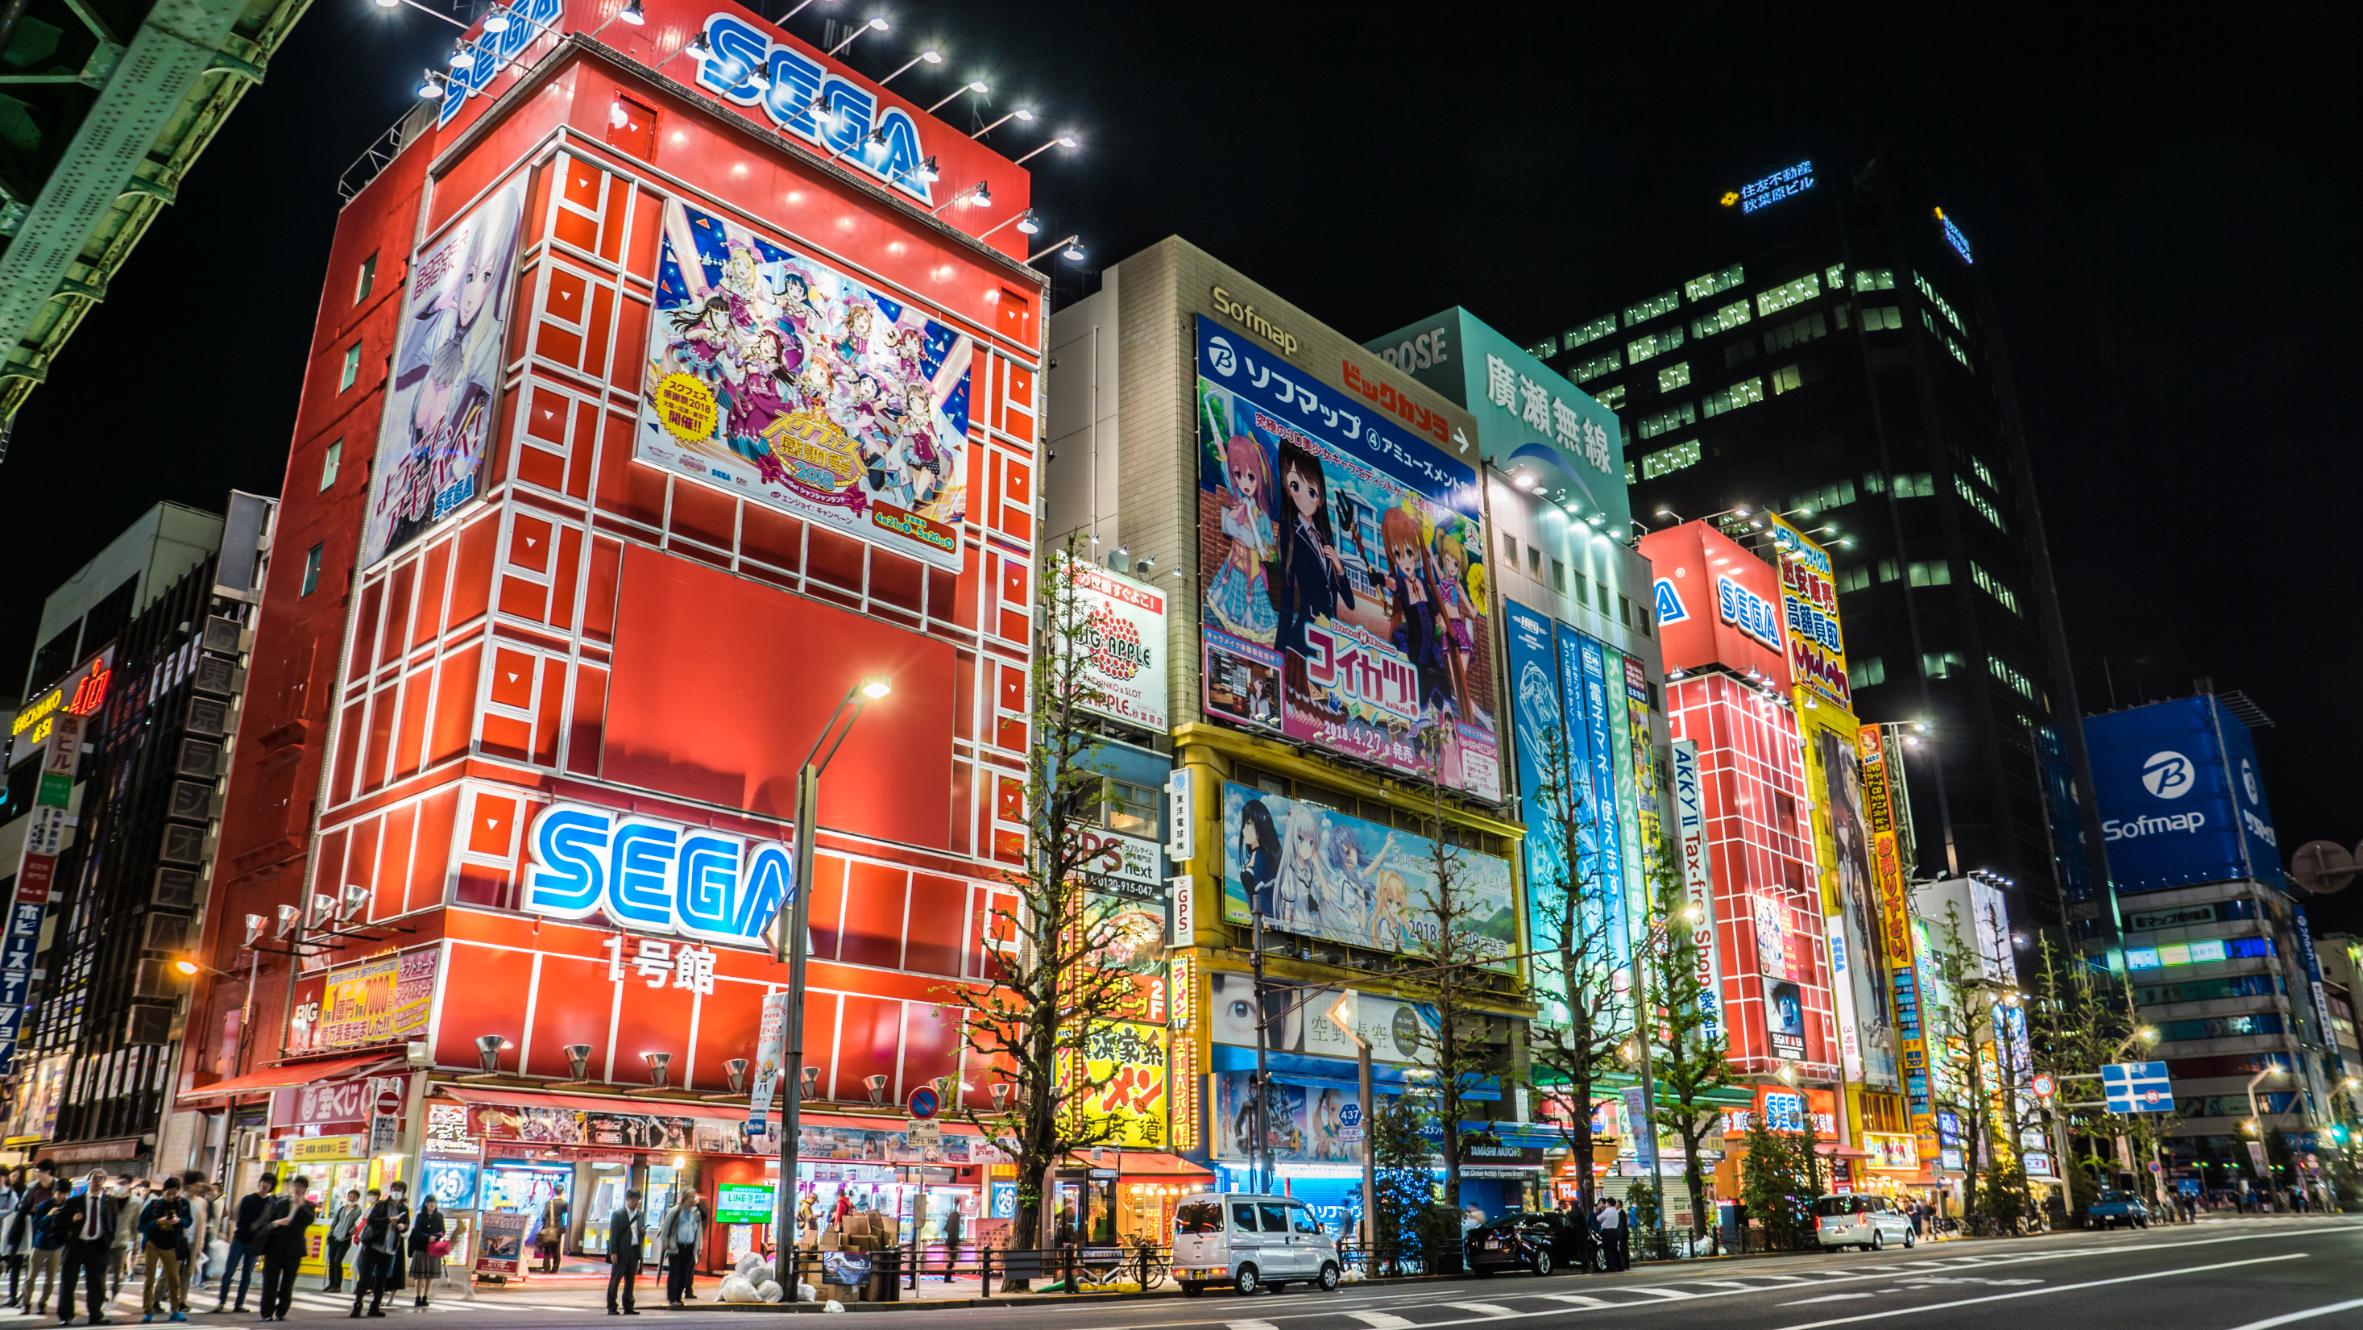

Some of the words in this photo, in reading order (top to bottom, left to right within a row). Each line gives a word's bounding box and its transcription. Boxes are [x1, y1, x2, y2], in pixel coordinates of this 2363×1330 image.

[695, 11, 934, 207] SEGA
[1741, 160, 1812, 199] 住友不動産
[1742, 176, 1814, 214] 秋葉原ビル
[1213, 287, 1298, 355] Sofmap
[663, 389, 711, 414] 感謝祭2018
[669, 381, 708, 401] スクフェス
[1245, 357, 1361, 439] ソフマップ
[1343, 359, 1449, 443] ビックカメラ
[668, 411, 702, 433] 開催!!
[1486, 353, 1612, 474] 廣瀬無線
[779, 431, 852, 478] 感謝祭
[795, 460, 835, 491] 2018
[432, 471, 475, 522] SEGA
[1718, 575, 1783, 655] SEGA
[1786, 596, 1841, 654] 高額買取
[1109, 636, 1152, 669] APPLE
[1124, 687, 1142, 698] SLOT
[2102, 811, 2205, 842] Sofmap
[523, 802, 802, 948] SEGA
[1125, 864, 1153, 879] next
[1675, 747, 1697, 811] AKKY
[1695, 931, 1712, 990] Shop
[1178, 889, 1188, 931] GPS
[603, 936, 717, 995] 1号館
[1831, 936, 1846, 973] SEGA
[1150, 980, 1164, 1020] 2F
[1173, 967, 1187, 1016] ラーメン
[1174, 1019, 1187, 1028] 1F
[317, 1085, 358, 1120] 宝くじ
[1341, 1109, 1360, 1120] 437
